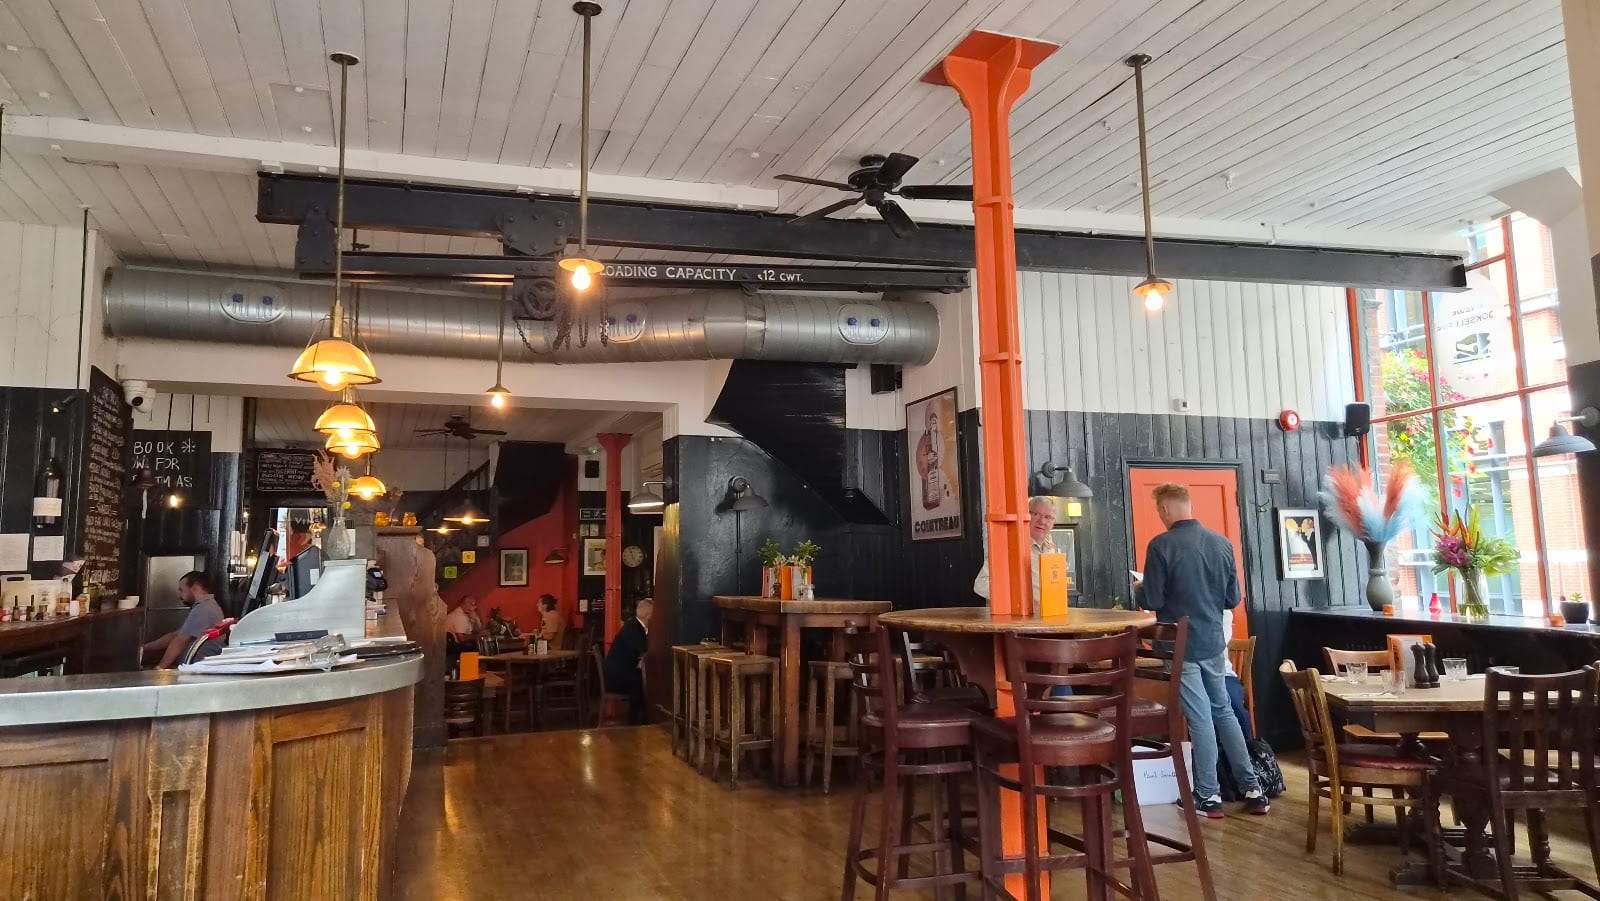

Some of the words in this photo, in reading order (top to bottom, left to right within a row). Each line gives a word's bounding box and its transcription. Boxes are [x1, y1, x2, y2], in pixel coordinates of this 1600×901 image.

[665, 267, 737, 281] CAPACITY
[779, 272, 804, 282] CWT.
[133, 441, 174, 455] BOOK
[155, 457, 180, 471] FOR
[914, 515, 960, 534] COINTREAU
